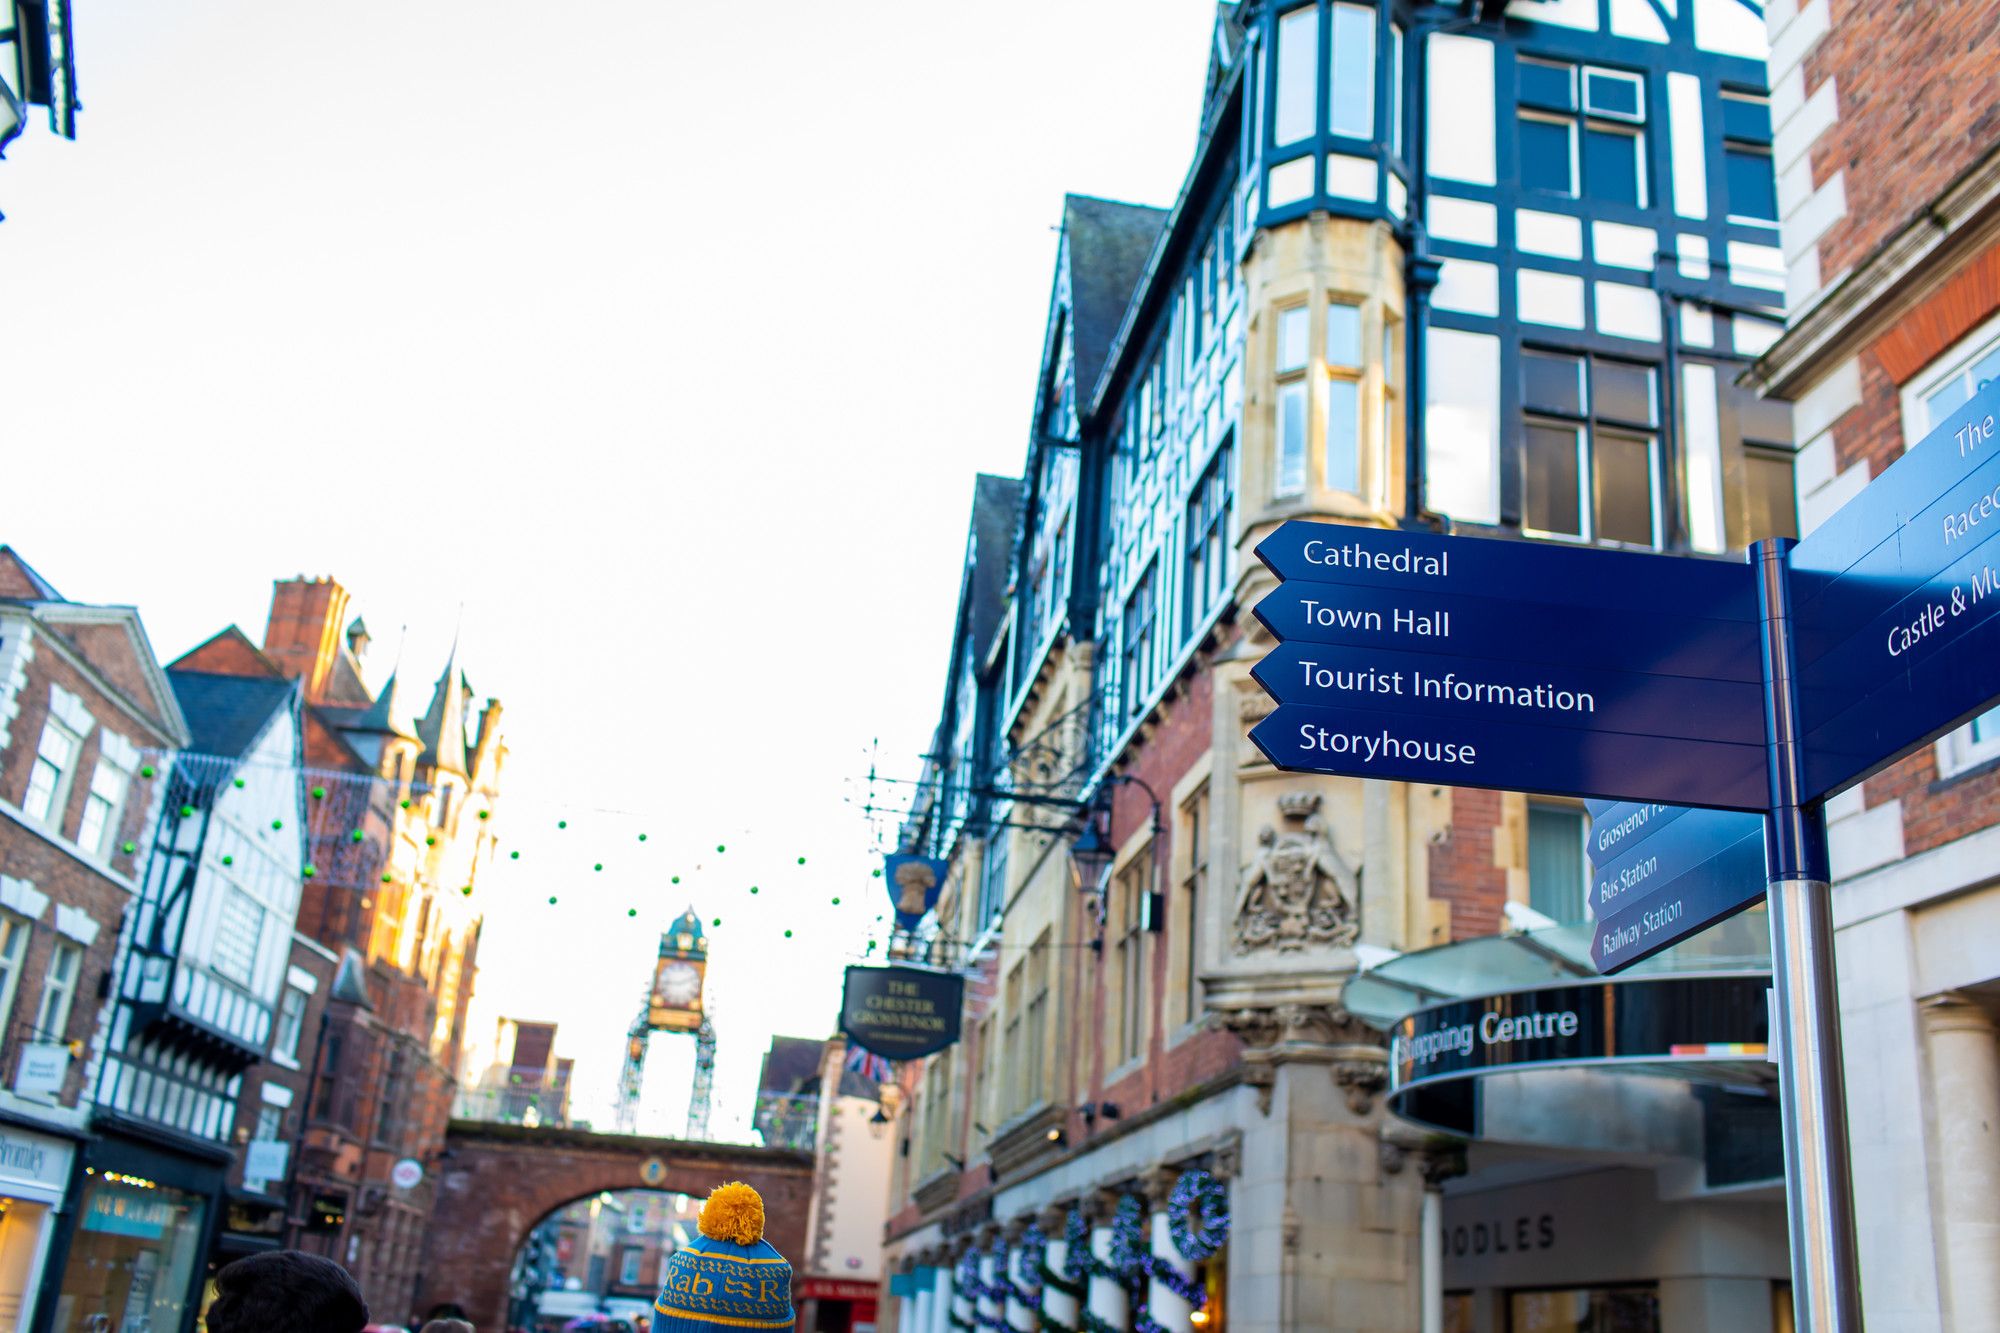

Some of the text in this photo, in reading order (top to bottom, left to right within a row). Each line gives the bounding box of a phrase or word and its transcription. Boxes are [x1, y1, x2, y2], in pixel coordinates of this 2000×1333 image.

[1954, 414, 1994, 458] The
[1303, 540, 1448, 577] Cathedral
[1300, 599, 1449, 637] Town Hall
[1888, 602, 1945, 657] Castle
[1950, 585, 1966, 617] &
[1299, 660, 1594, 712] Tourist Information
[1299, 723, 1476, 765] Storyhouse
[1598, 804, 1650, 852] Grosvenor
[1601, 855, 1658, 904] Bus Station
[1602, 898, 1682, 957] Railway Station
[887, 980, 918, 996] THE
[1397, 1011, 1579, 1066] Shopping Centre
[668, 1264, 714, 1296] Rab
